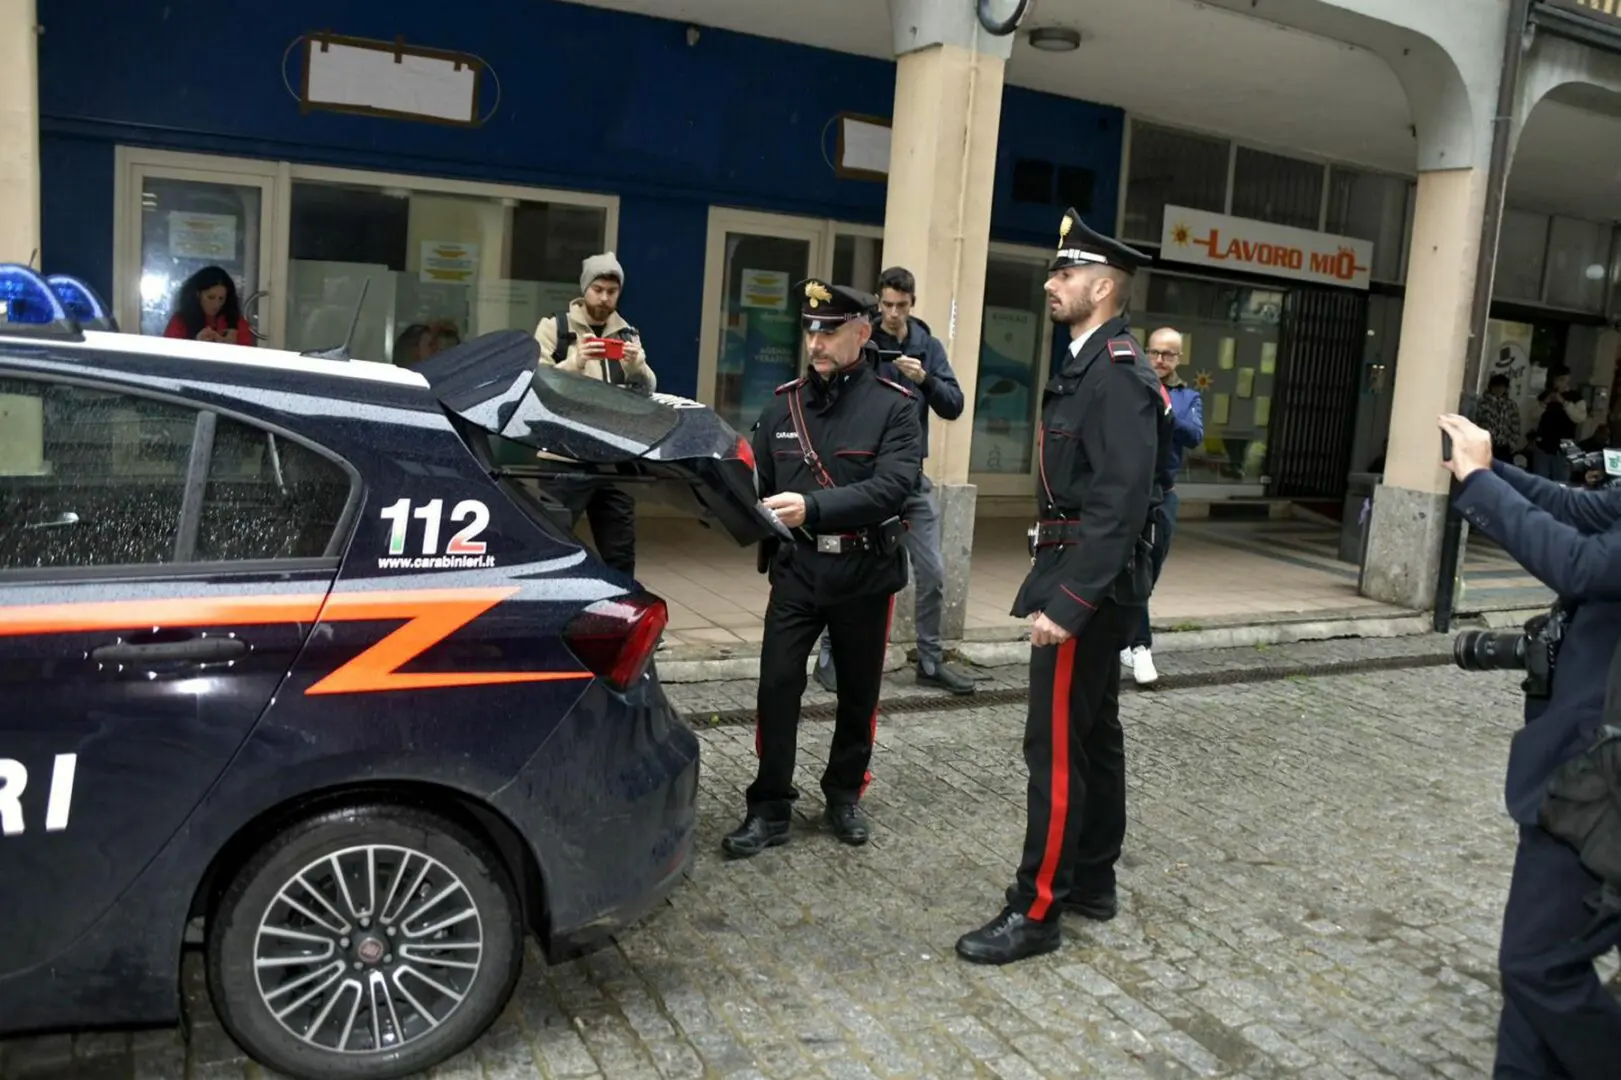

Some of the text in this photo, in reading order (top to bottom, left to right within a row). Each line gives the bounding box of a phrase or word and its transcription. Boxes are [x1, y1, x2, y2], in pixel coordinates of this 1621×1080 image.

[1208, 229, 1303, 270] LAVORO
[380, 498, 490, 555] 112
[378, 555, 496, 569] www.carabinieri.it
